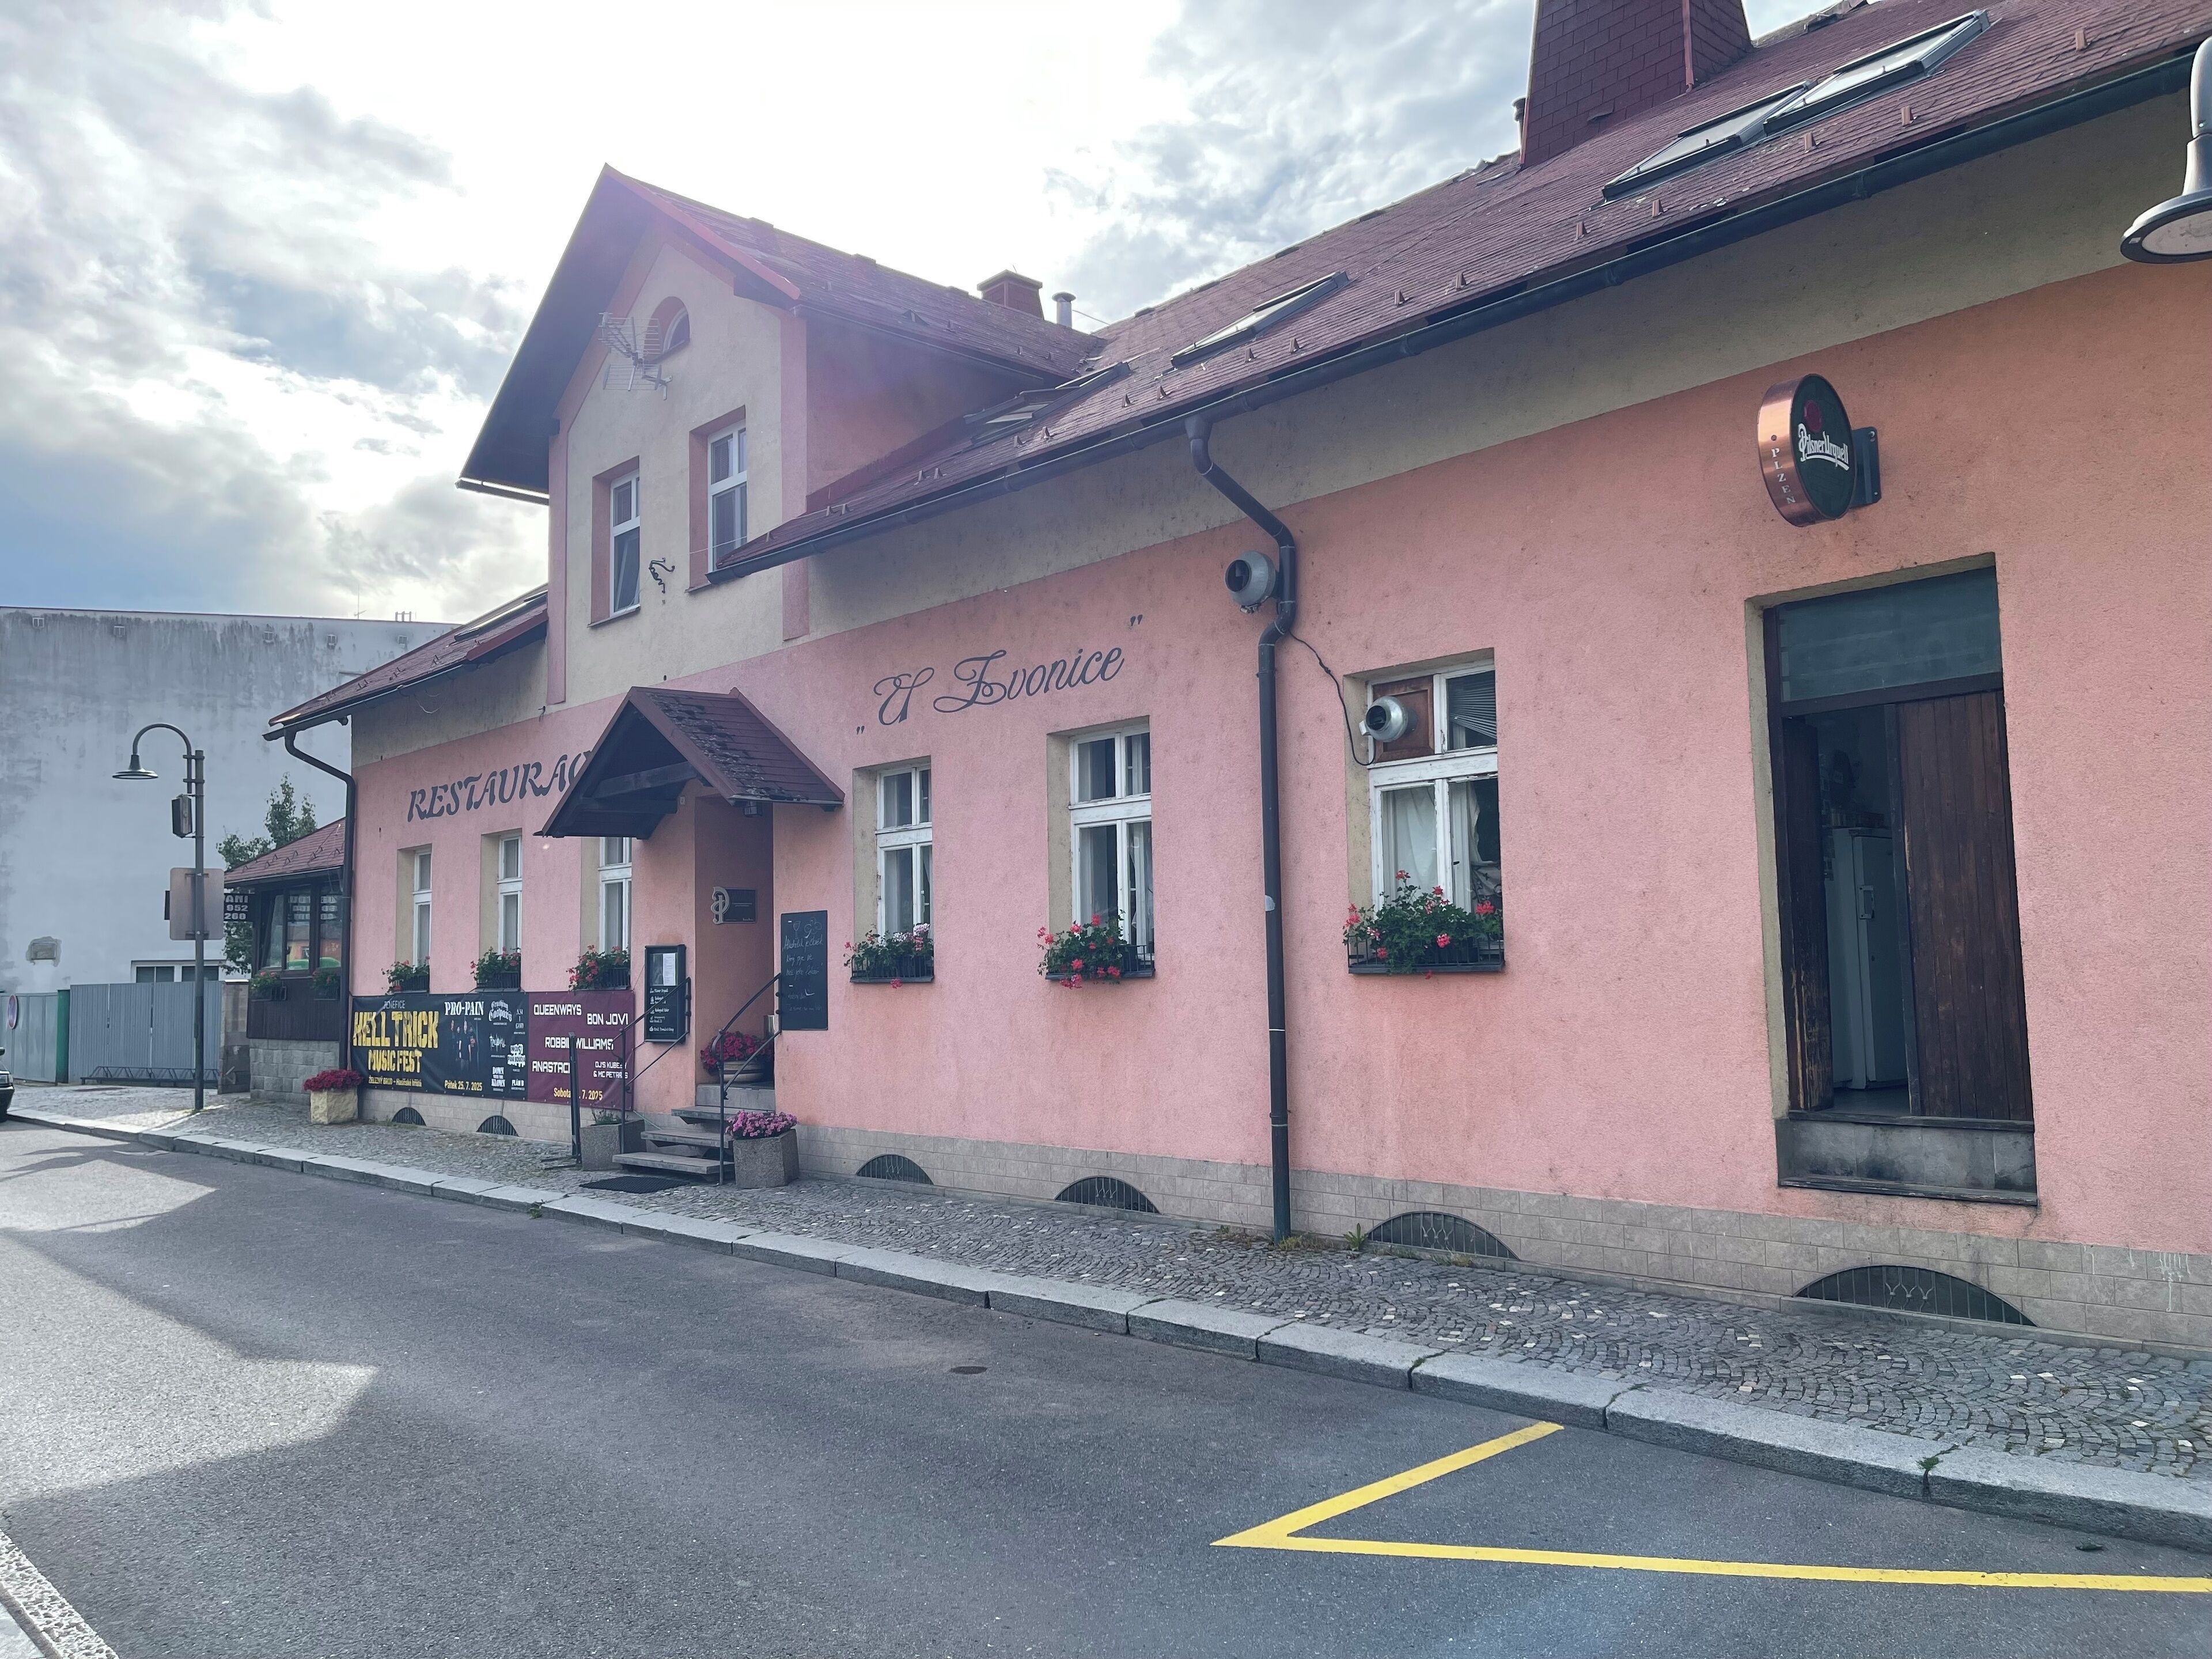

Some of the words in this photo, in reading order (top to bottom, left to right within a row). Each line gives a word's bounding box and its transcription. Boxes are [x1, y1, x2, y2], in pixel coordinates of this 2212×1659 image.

[1798, 423, 1825, 461] Pilsner
[1823, 431, 1849, 467] Urquell
[407, 749, 593, 822] RESTAURAC
[444, 1001, 484, 1016] PRO-PAIN
[533, 1004, 582, 1016] QUEENWAYS
[586, 1013, 604, 1025] BON
[605, 1013, 629, 1025] JOVI
[353, 1011, 391, 1047] HELL
[391, 1011, 439, 1048] TRICK
[545, 1036, 570, 1049] ROBBI
[576, 1037, 614, 1050] WILLIAMS
[368, 1049, 396, 1073] MUSIC
[396, 1048, 423, 1073] FEST
[532, 1060, 570, 1074] ANASTACI
[606, 1071, 628, 1079] PETRAS
[444, 1080, 457, 1089] Pátek
[471, 1082, 483, 1091] 2025
[554, 1087, 571, 1099] Sobota
